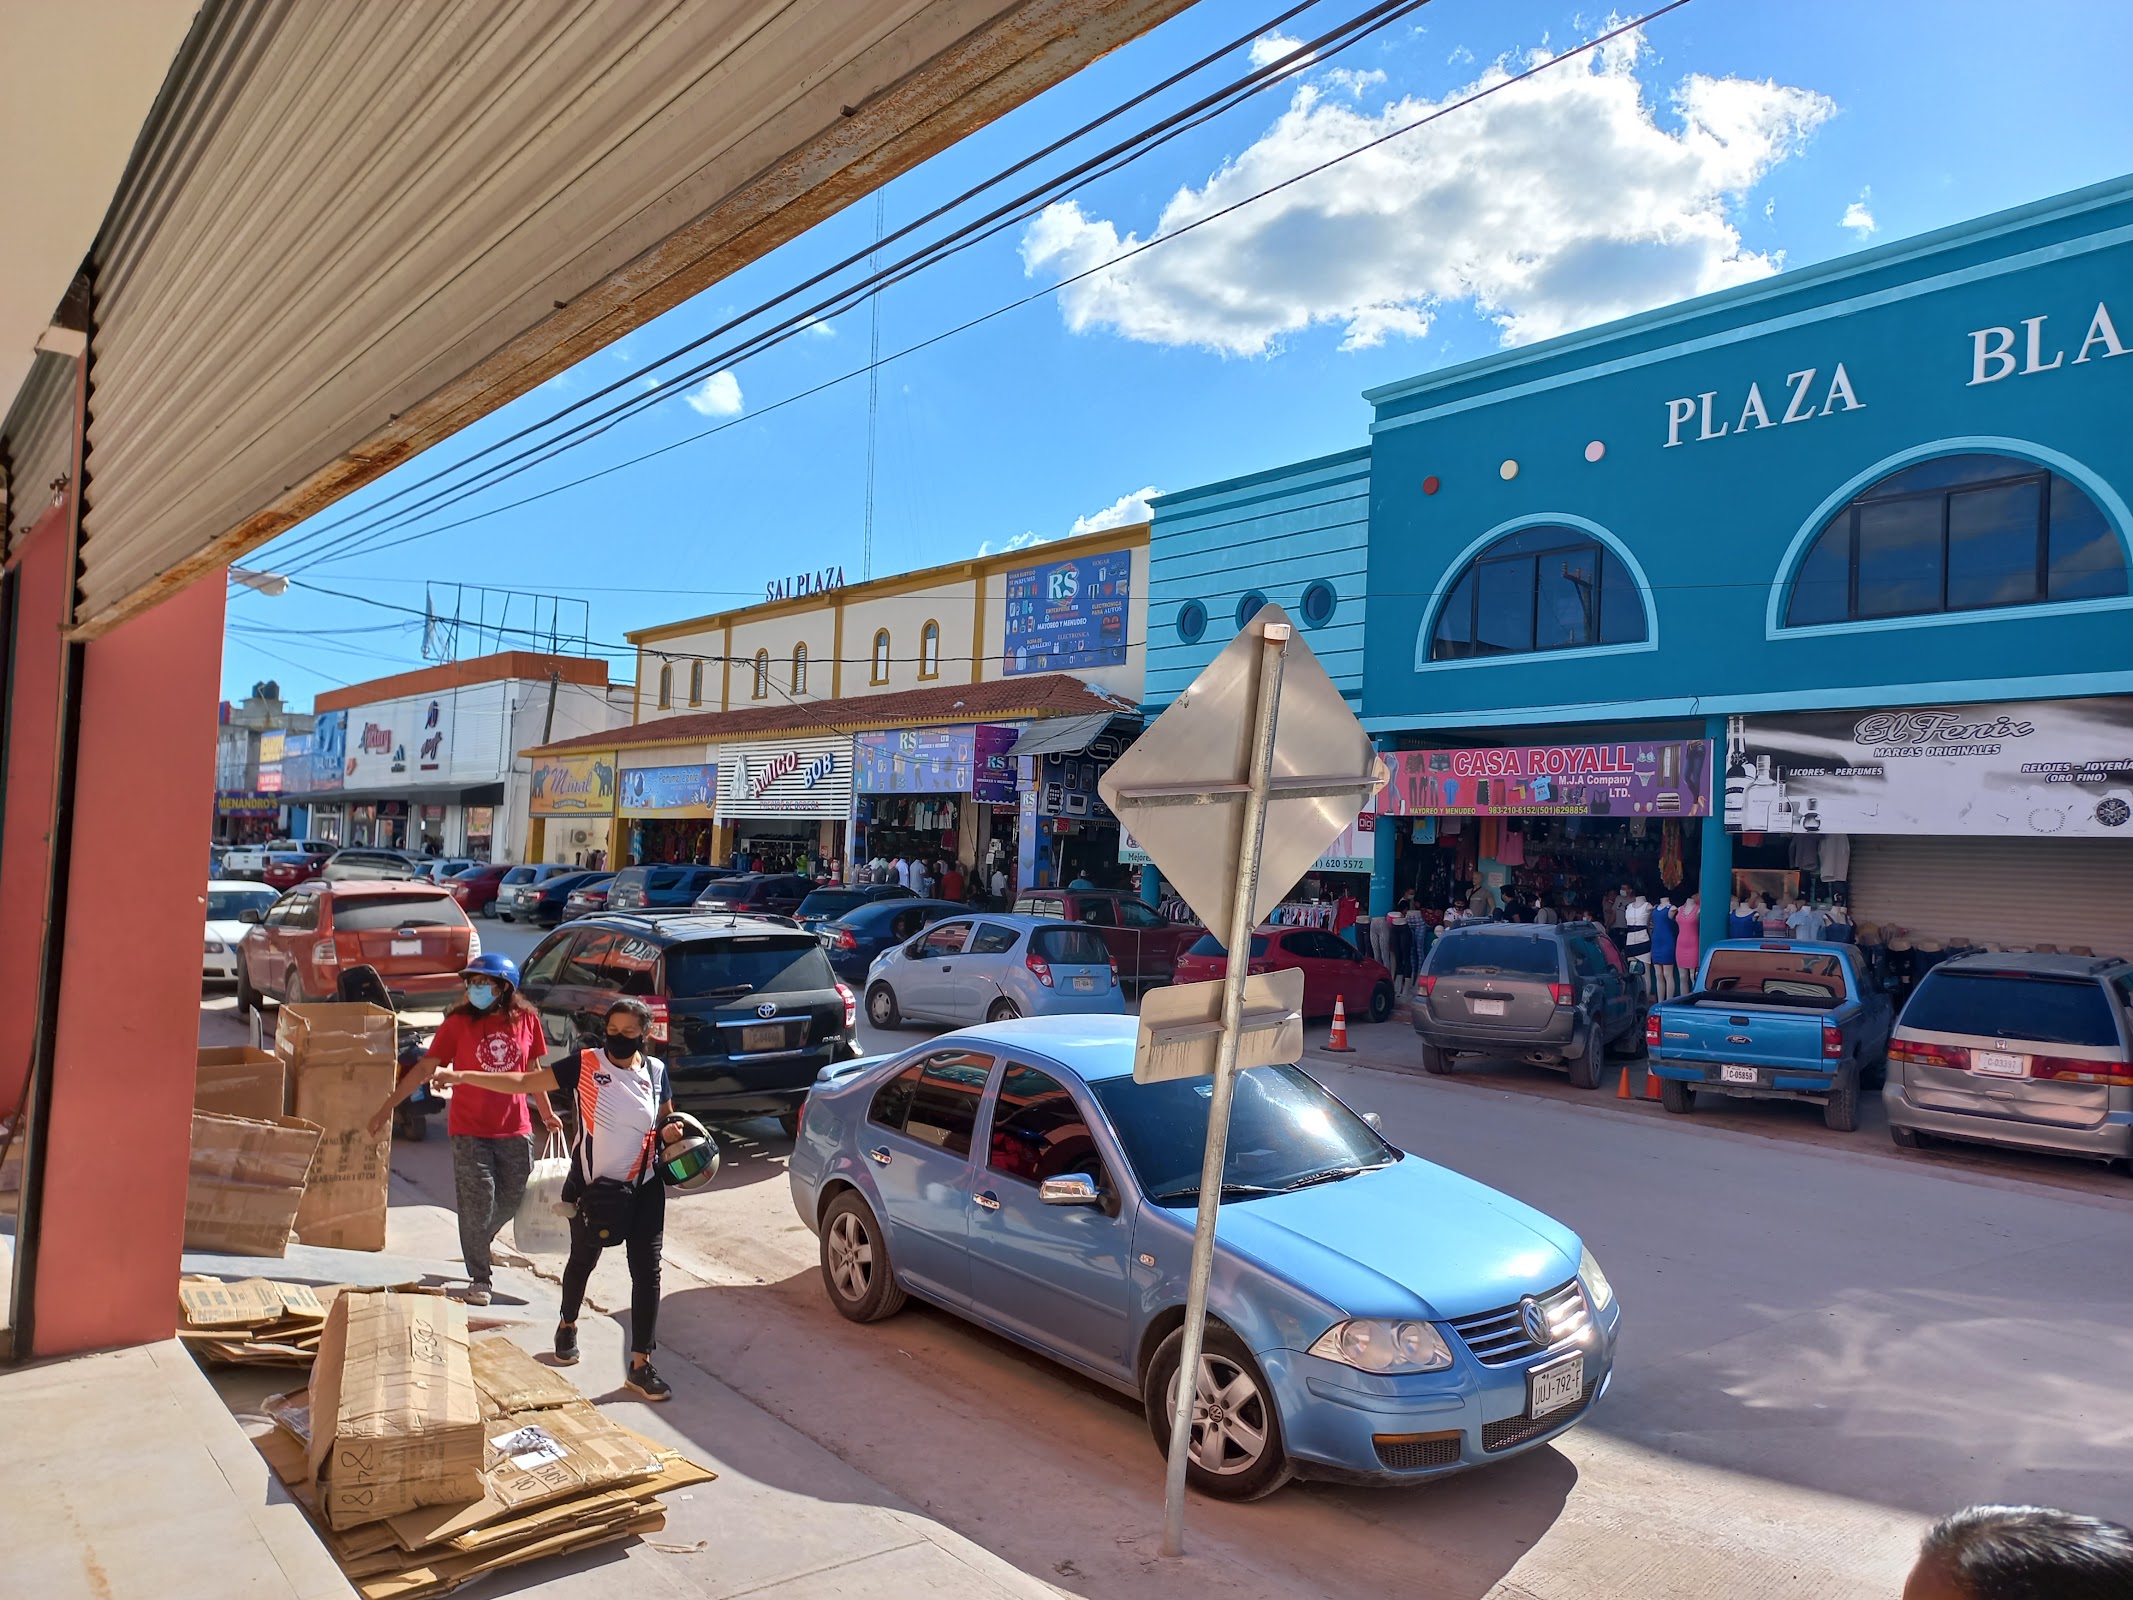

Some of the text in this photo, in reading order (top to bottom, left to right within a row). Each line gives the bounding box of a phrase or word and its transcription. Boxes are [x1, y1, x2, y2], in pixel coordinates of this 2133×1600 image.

[1663, 301, 2133, 448] PLAZA BLA
[796, 565, 844, 597] PLAZA
[1049, 572, 1078, 599] RS
[1063, 617, 1087, 627] MENUDEO
[1854, 711, 2035, 745] El Fenix
[900, 731, 917, 750] RS
[1873, 744, 2002, 758] MARCAS ORIGINALES
[987, 756, 1004, 768] RS
[1453, 746, 1634, 776] CASA ROYALL
[1789, 768, 1825, 776] LICORES
[1834, 767, 1883, 776] PERFUMES
[2021, 762, 2072, 773] RELOJES
[752, 751, 834, 798] AMIGO BOB
[1559, 775, 1632, 786] M.J.A Company
[2046, 773, 2107, 783] (ORO FINO)
[1609, 788, 1631, 798] LTD.
[219, 798, 278, 810] MENANDRO'S
[1023, 793, 1035, 806] RS
[1410, 807, 1438, 815] MAYOREO
[1445, 807, 1476, 815] MENUDEO
[1326, 859, 1341, 868] 620
[1343, 860, 1363, 869] 5572
[1535, 1370, 1581, 1405] UUJ-792-F
